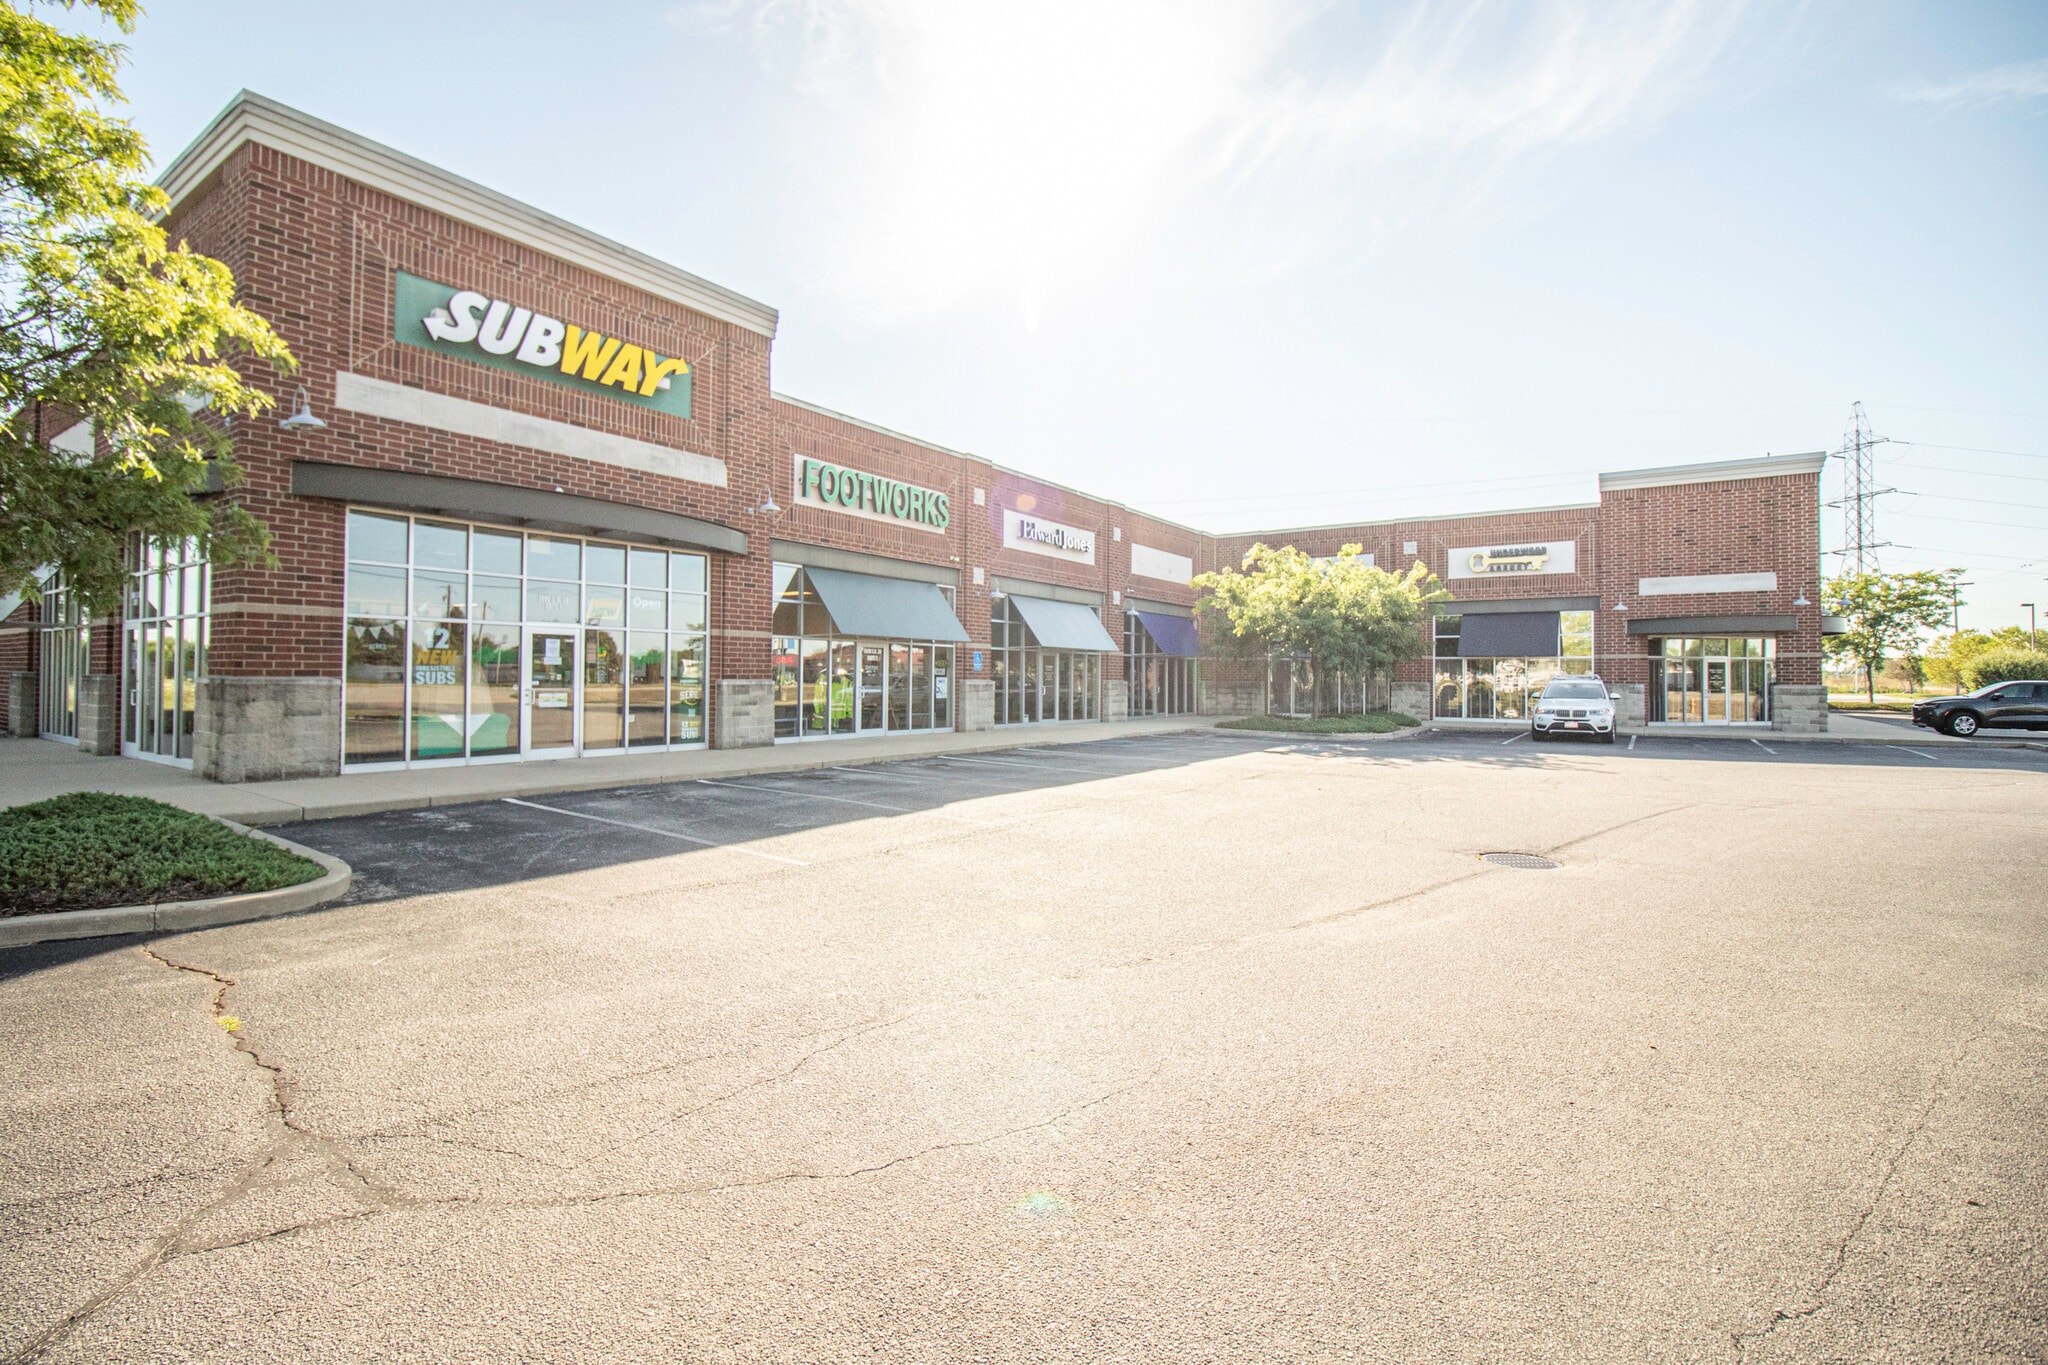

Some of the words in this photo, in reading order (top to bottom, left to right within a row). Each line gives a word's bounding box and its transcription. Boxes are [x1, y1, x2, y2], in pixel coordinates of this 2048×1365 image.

[423, 291, 689, 397] SUBWAY
[801, 459, 950, 528] FOOTWORKS
[1020, 520, 1062, 546] Edward
[1061, 530, 1092, 552] Jones
[1490, 546, 1547, 558] UNDERWOOD
[632, 596, 661, 608] Open
[424, 627, 450, 649] 12
[416, 650, 458, 665] NEW
[415, 671, 457, 685] SUBS
